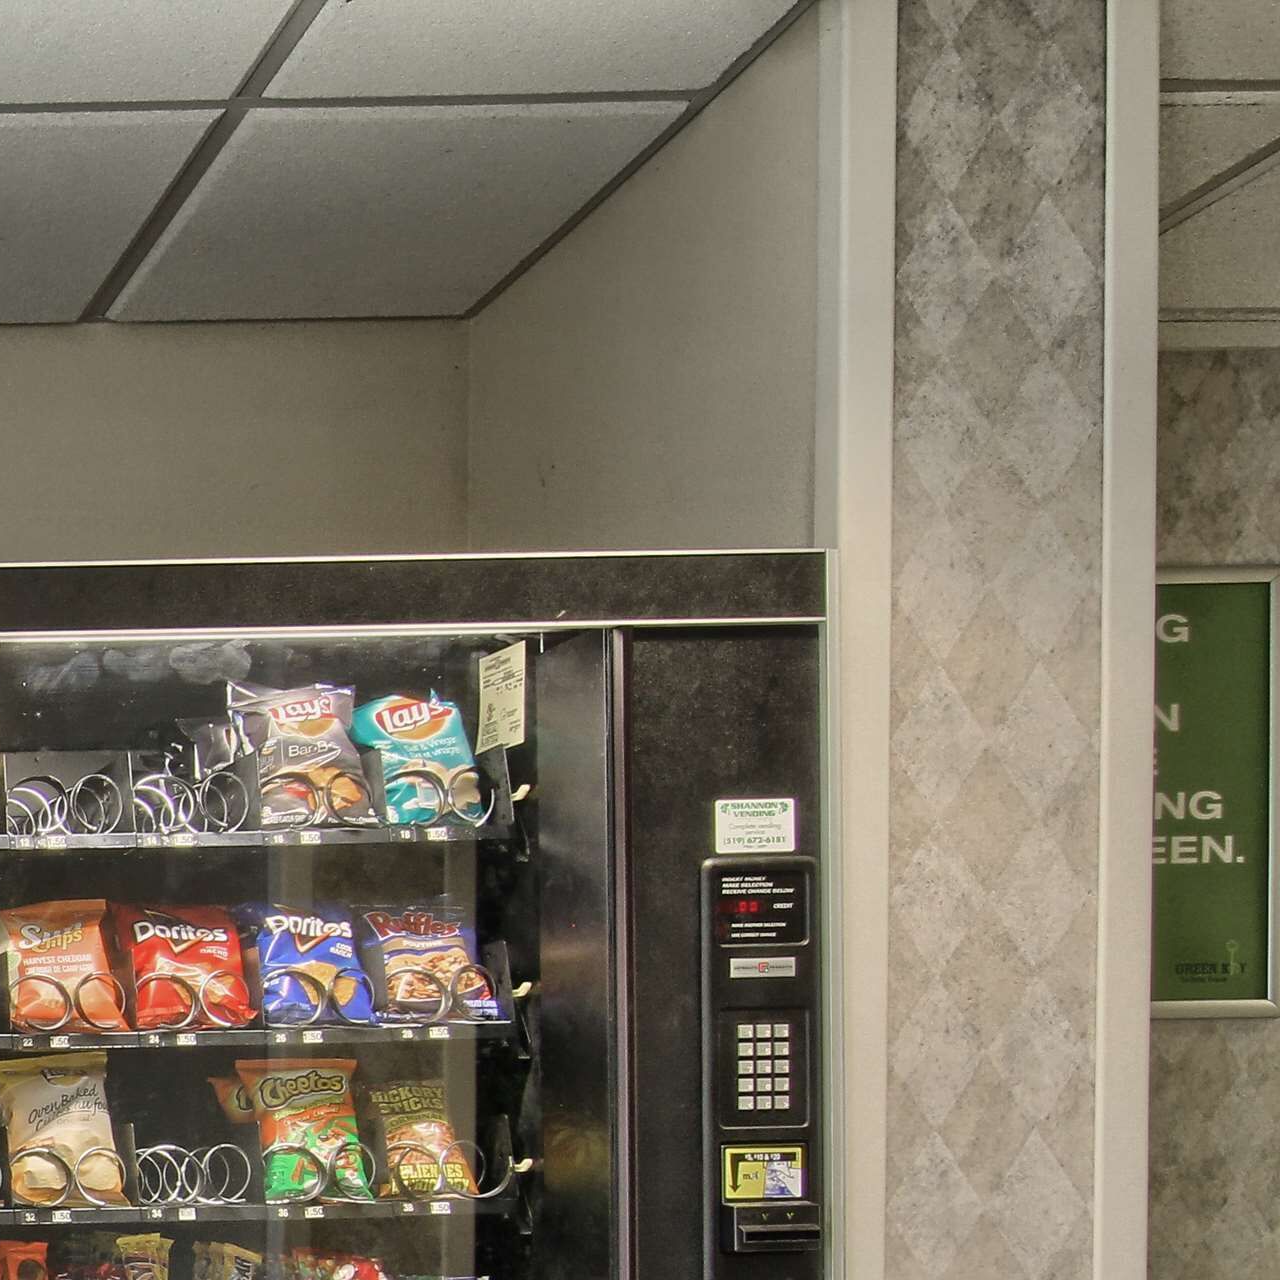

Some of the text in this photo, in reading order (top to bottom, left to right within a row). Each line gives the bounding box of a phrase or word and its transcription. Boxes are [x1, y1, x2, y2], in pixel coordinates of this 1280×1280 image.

[133, 922, 229, 944] Doritos
[264, 915, 353, 938] Doritos
[363, 911, 461, 941] Ruffles
[23, 1038, 33, 1047] 22
[149, 1034, 160, 1044] 24
[261, 1075, 344, 1108] Cheetos
[370, 1086, 442, 1103] HICKORY
[28, 1085, 99, 1124] Oven Baked
[379, 1098, 443, 1115] STICKS
[25, 1212, 36, 1222] 32
[151, 1209, 162, 1218] 34
